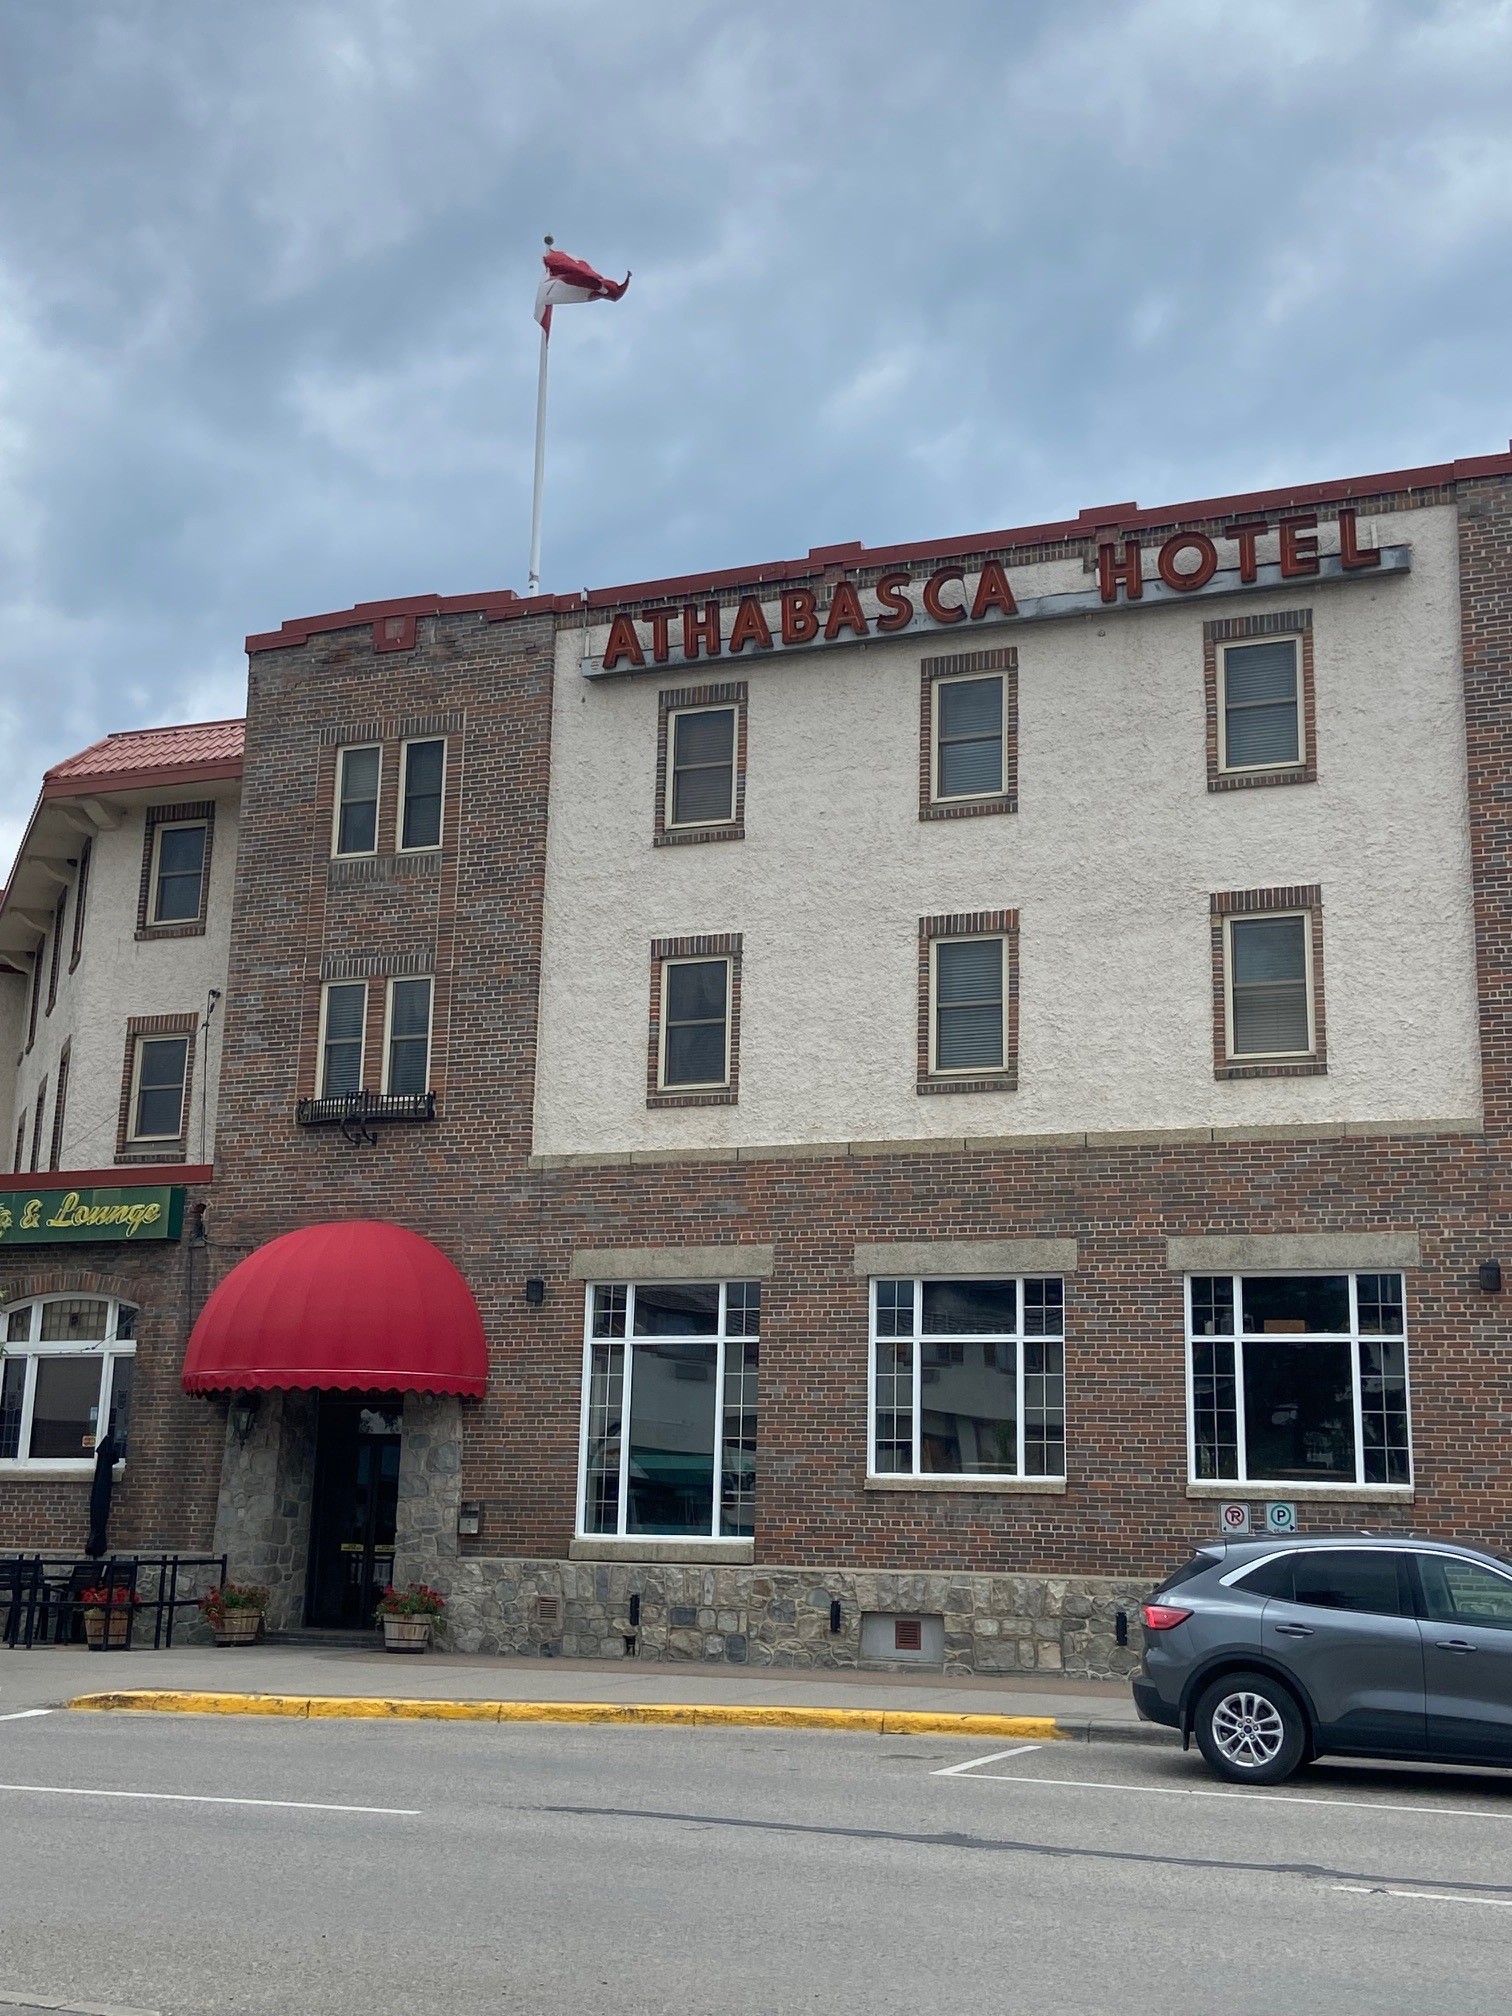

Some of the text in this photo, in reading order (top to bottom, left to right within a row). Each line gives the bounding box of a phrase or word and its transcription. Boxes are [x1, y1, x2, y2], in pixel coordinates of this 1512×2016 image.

[602, 508, 1382, 669] ATHABASCA HOTEL
[20, 1199, 42, 1229] &
[46, 1192, 161, 1237] Lounge
[1276, 1509, 1286, 1522] P
